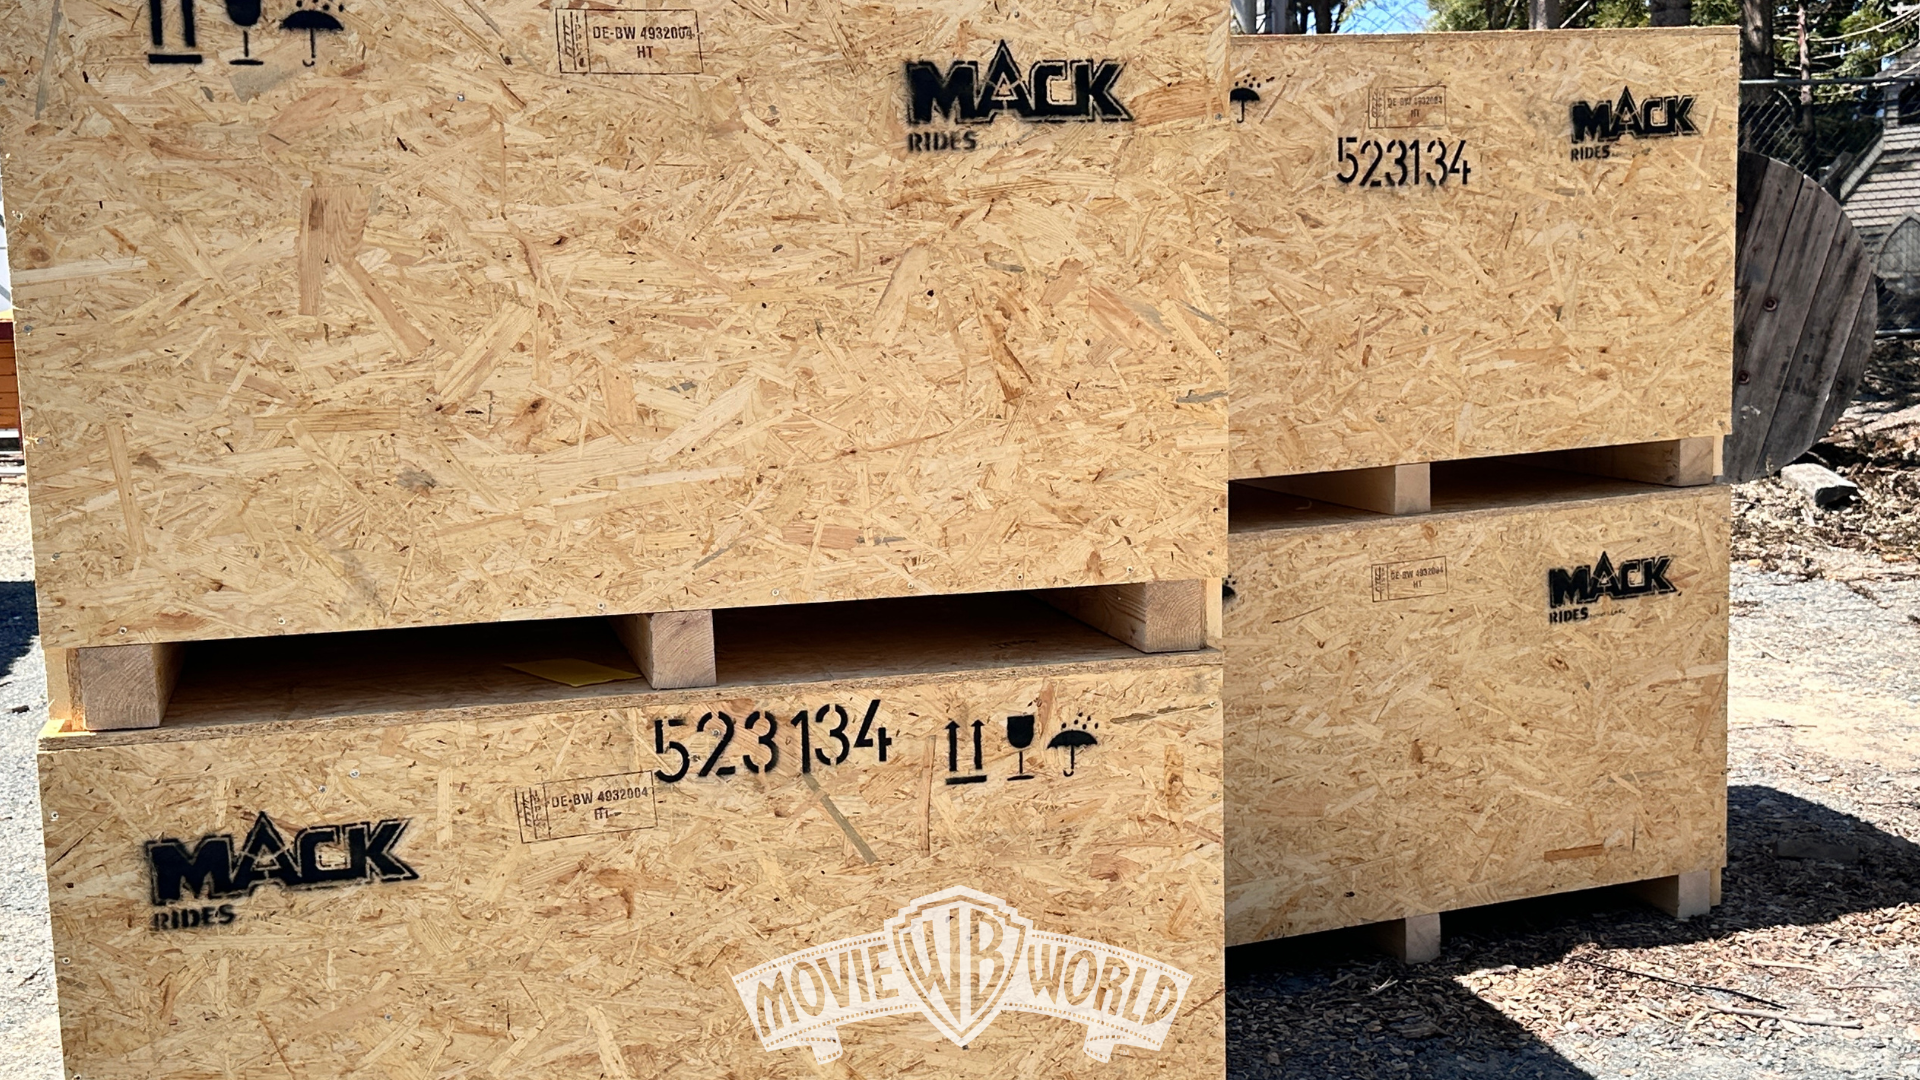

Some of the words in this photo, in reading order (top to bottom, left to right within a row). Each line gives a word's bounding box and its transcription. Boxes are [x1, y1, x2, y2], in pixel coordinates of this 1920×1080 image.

[593, 26, 636, 40] DE-BW
[640, 26, 694, 40] 4932004
[637, 46, 654, 59] HT
[906, 39, 1134, 125] MACK
[1571, 85, 1701, 144] MACK
[908, 131, 977, 152] RIDES
[1571, 145, 1610, 162] RIDES
[1336, 136, 1471, 187] 523134
[1548, 551, 1678, 608] MACK
[1549, 607, 1589, 624] RIDES
[654, 699, 892, 784] 523134
[597, 786, 649, 803] 4932004
[145, 811, 420, 906] MACK
[153, 904, 236, 932] RIDES
